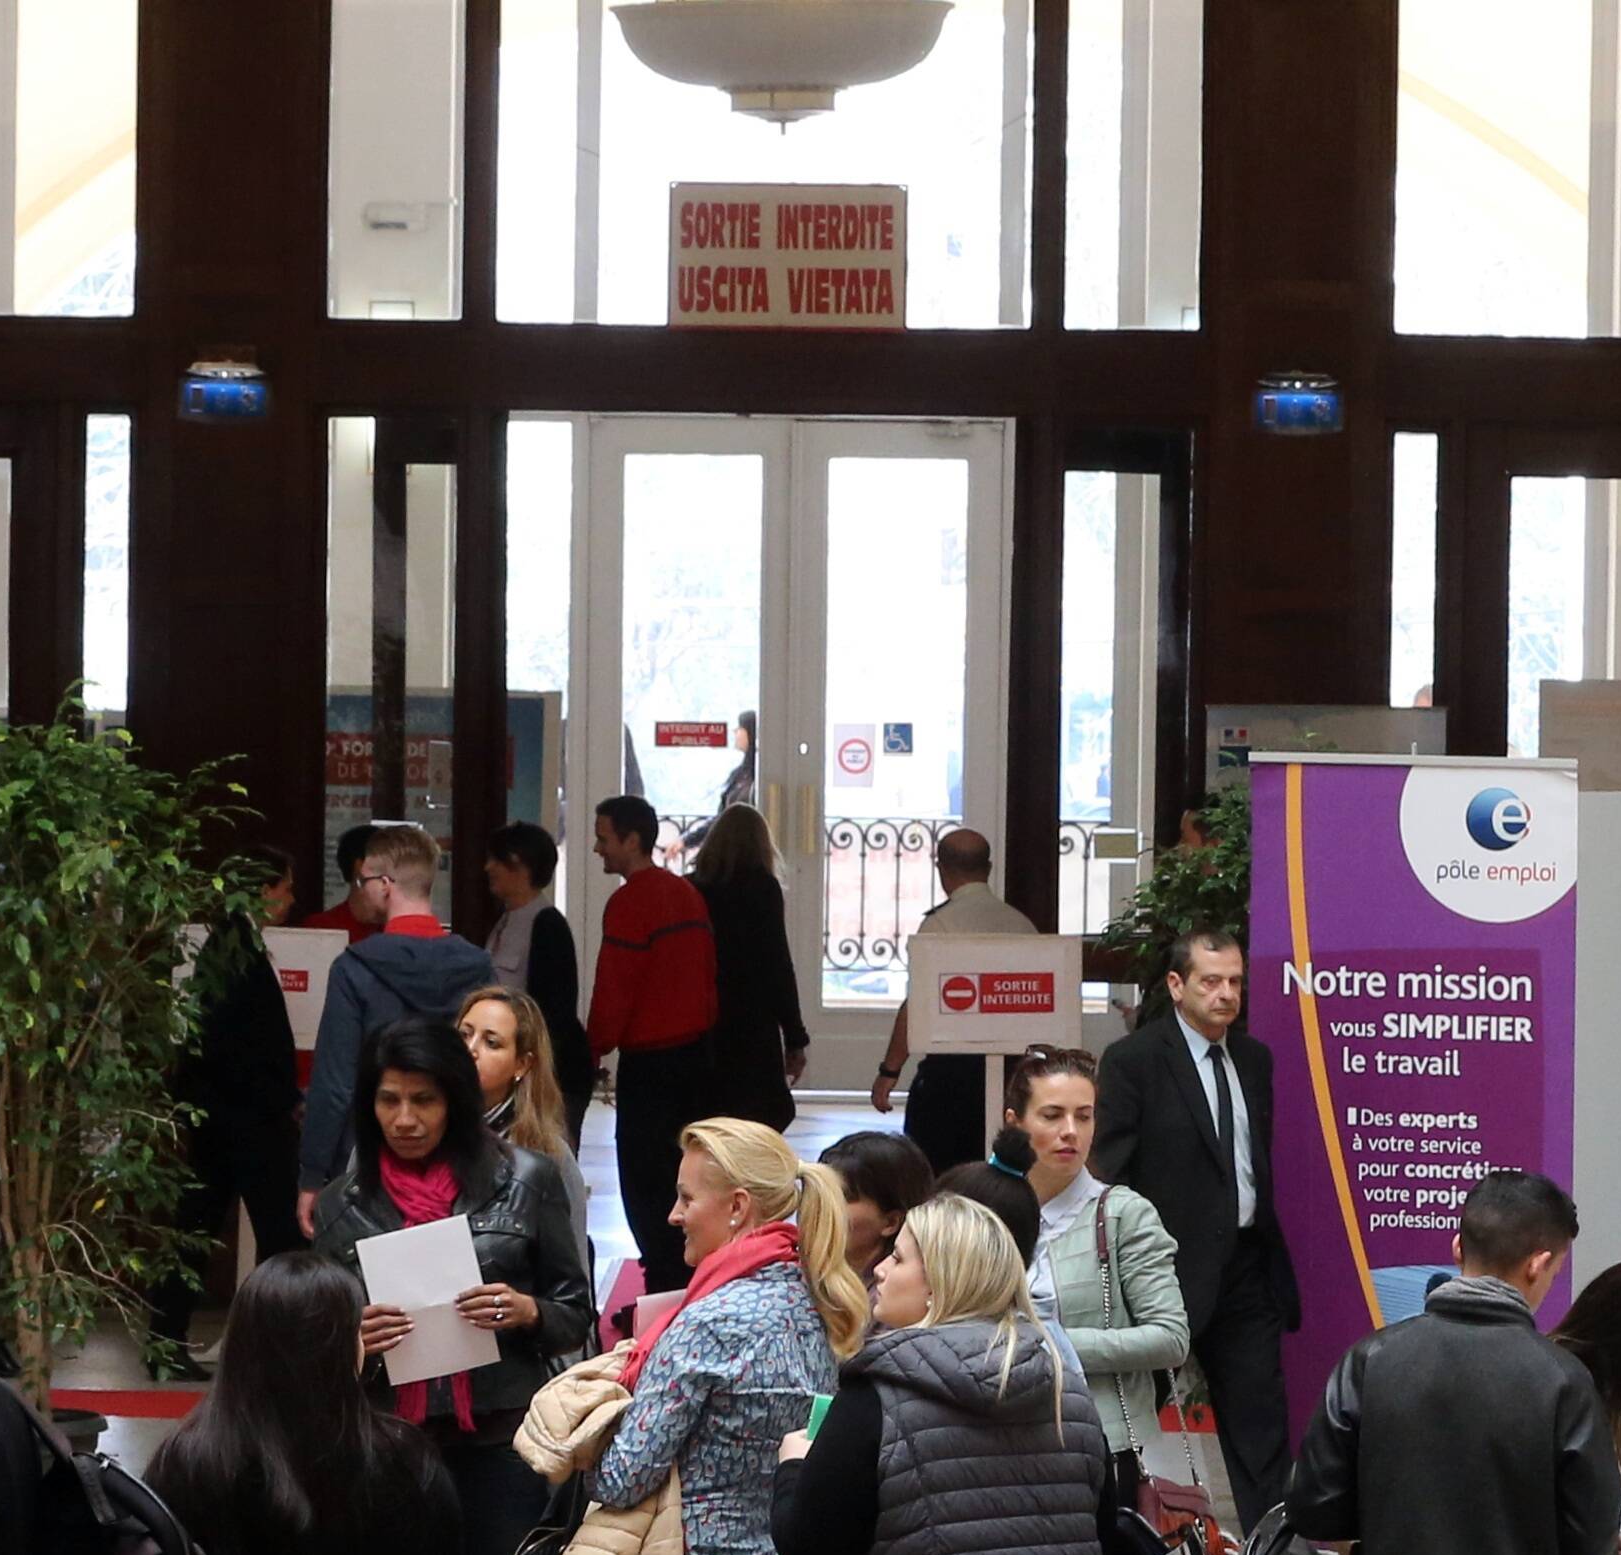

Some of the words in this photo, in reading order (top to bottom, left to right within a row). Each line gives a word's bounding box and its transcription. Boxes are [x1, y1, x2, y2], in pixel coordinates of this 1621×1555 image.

[680, 202, 760, 249] SORTIE
[777, 204, 893, 250] INTERDITE
[678, 265, 770, 314] USCITA
[787, 268, 894, 314] VIETATA
[671, 736, 710, 746] PUBLIC
[708, 724, 724, 735] AU
[1437, 859, 1480, 886] pôle
[1487, 862, 1557, 886] emploi
[993, 980, 1040, 992] SORTIE
[1283, 961, 1387, 998] Notre
[1398, 965, 1533, 1002] mission
[982, 994, 1051, 1005] INTERDITE
[1330, 1020, 1376, 1039] vous
[1383, 1012, 1533, 1042] SIMPLIFIER
[1342, 1046, 1366, 1074] le
[1375, 1048, 1461, 1077] travail
[1361, 1109, 1393, 1126] Des
[1399, 1111, 1478, 1133] experts
[1352, 1133, 1362, 1150] à
[1368, 1137, 1414, 1152] votre
[1420, 1137, 1481, 1154] service
[1358, 1162, 1399, 1181] pour
[1364, 1186, 1410, 1202] votre
[1415, 1185, 1468, 1209] proje
